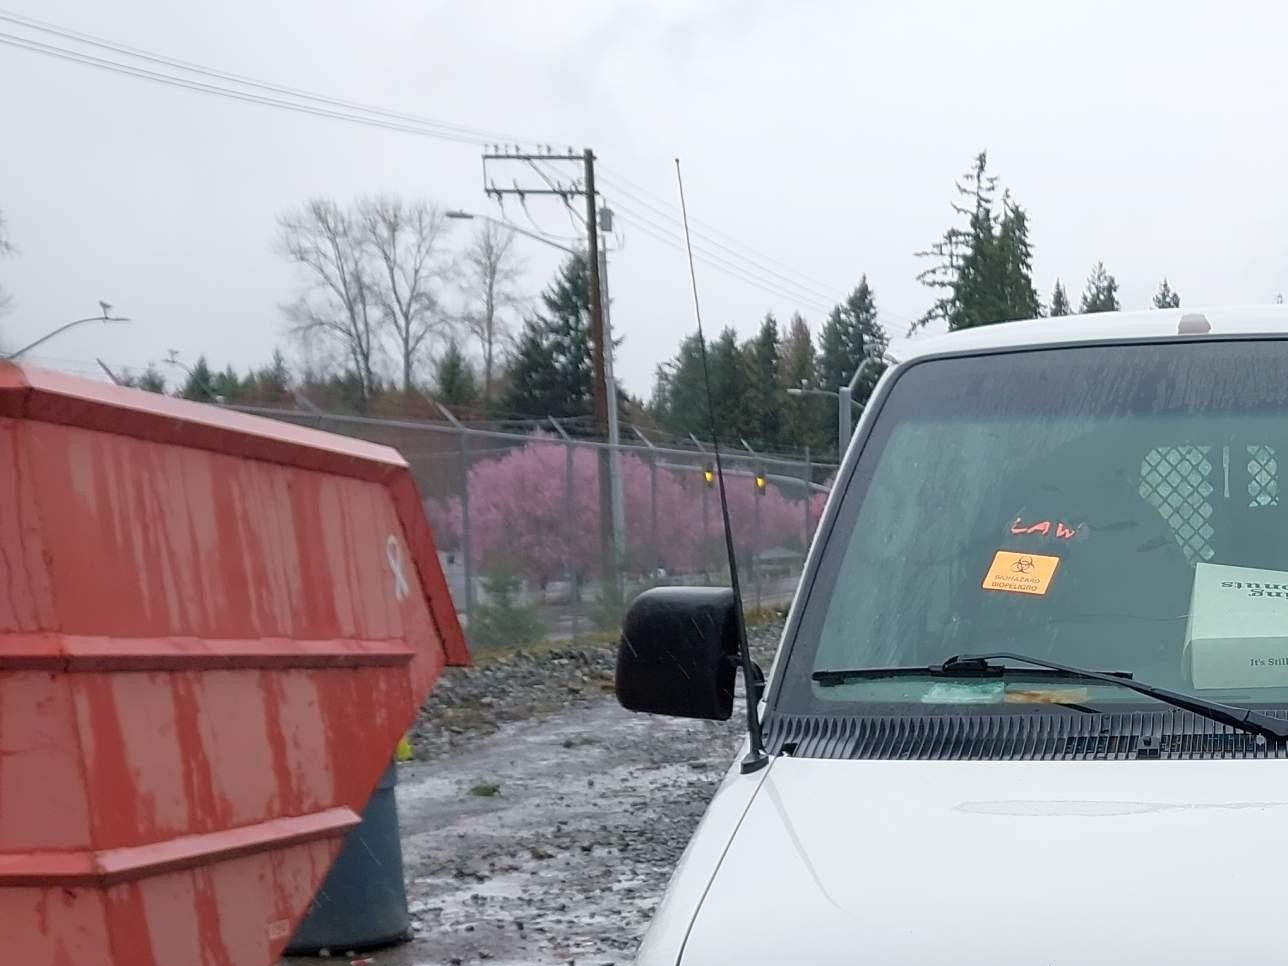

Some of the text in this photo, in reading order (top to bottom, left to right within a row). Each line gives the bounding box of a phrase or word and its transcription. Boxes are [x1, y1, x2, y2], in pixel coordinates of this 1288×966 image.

[994, 575, 1041, 584] BIOHAZARD
[991, 582, 1038, 592] BIOPELIGRO
[1250, 658, 1265, 667] It's
[1268, 657, 1288, 666] Still
